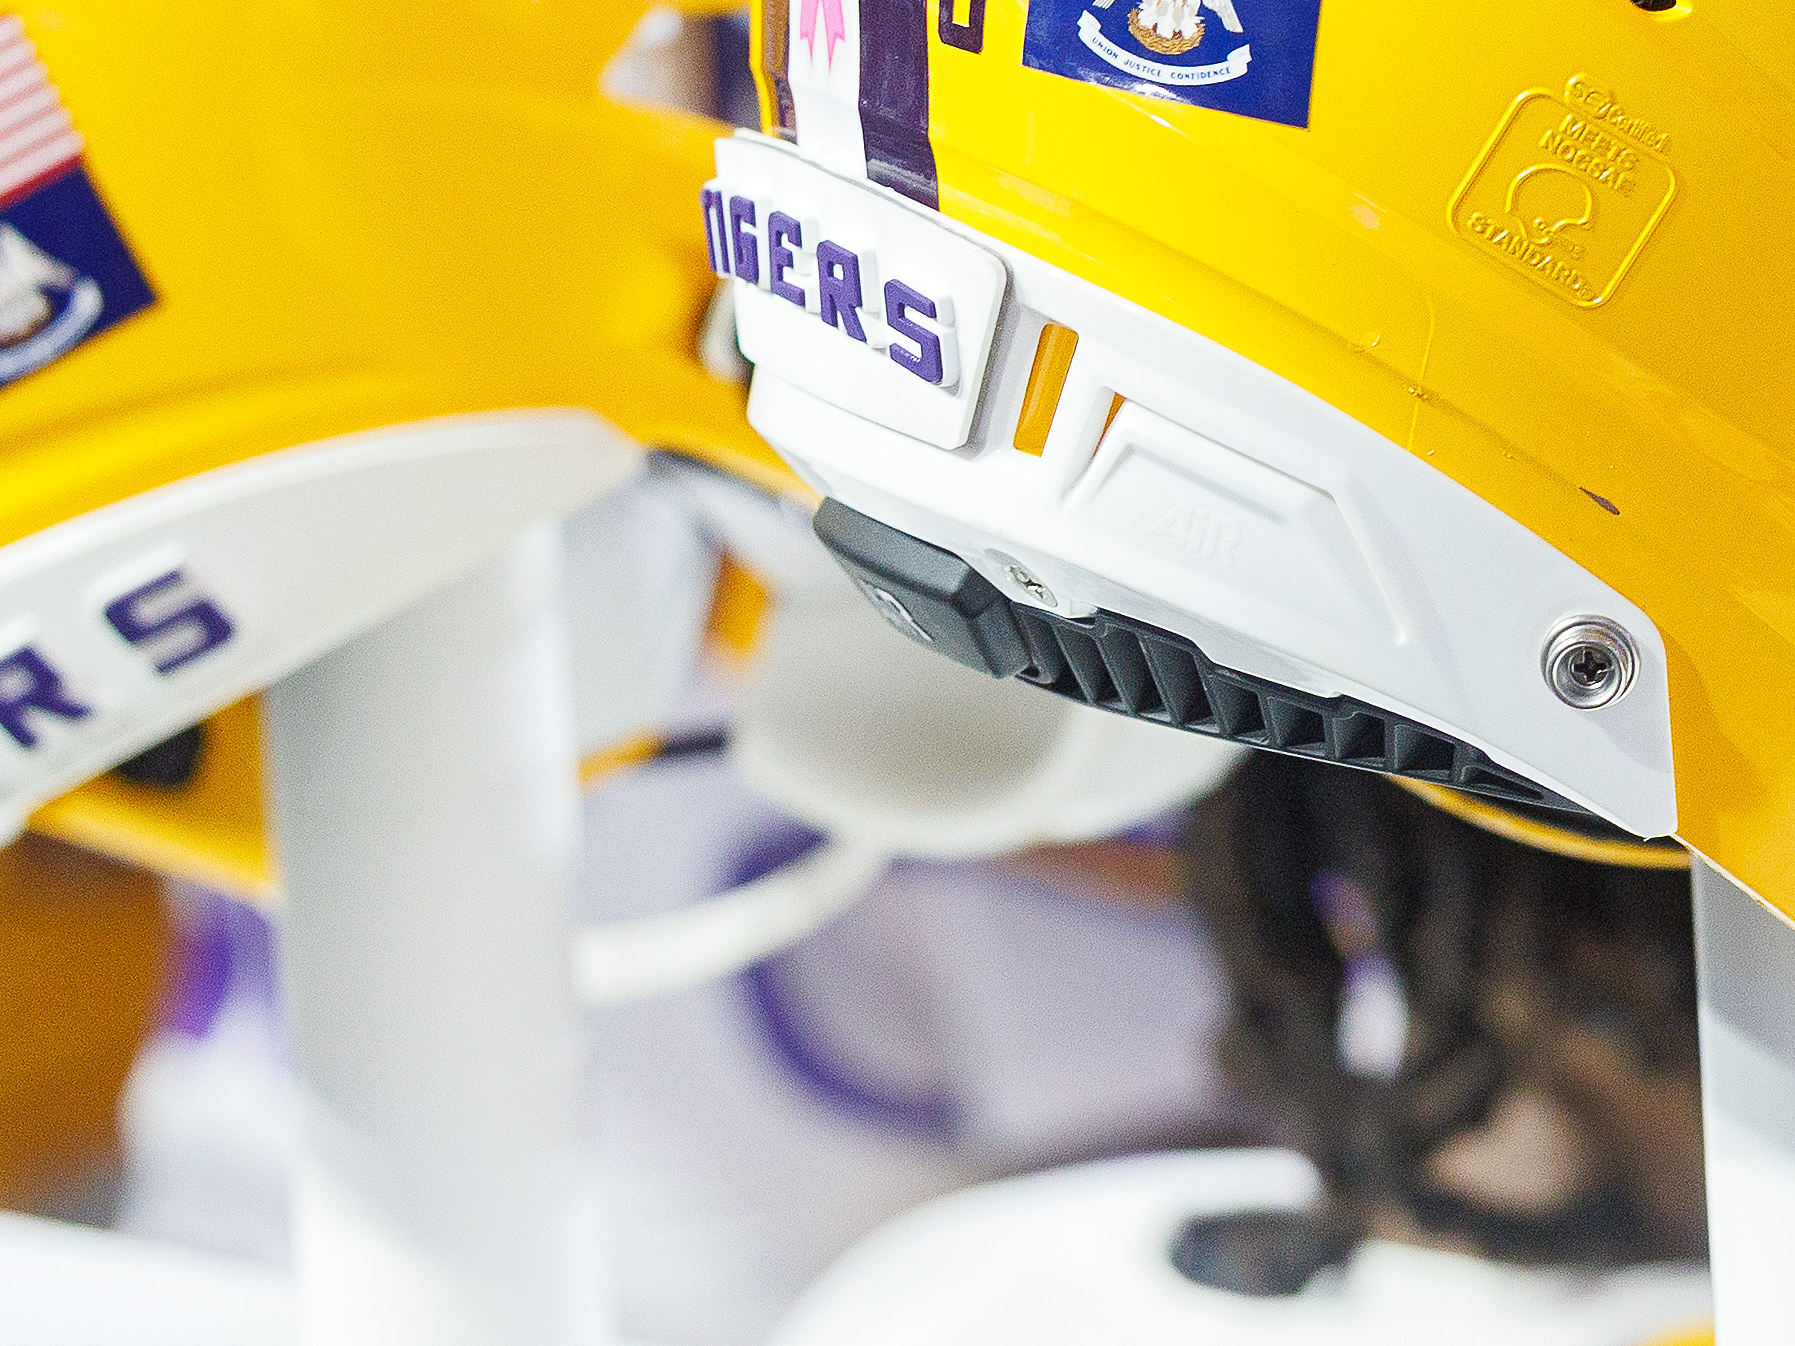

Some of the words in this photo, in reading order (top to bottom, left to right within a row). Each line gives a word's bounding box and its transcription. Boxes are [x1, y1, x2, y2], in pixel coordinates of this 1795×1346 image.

[1091, 36, 1119, 60] UNION
[1124, 58, 1162, 78] JUSTICE
[1170, 66, 1232, 80] CONFIDENCE
[700, 187, 943, 386] TIGERS
